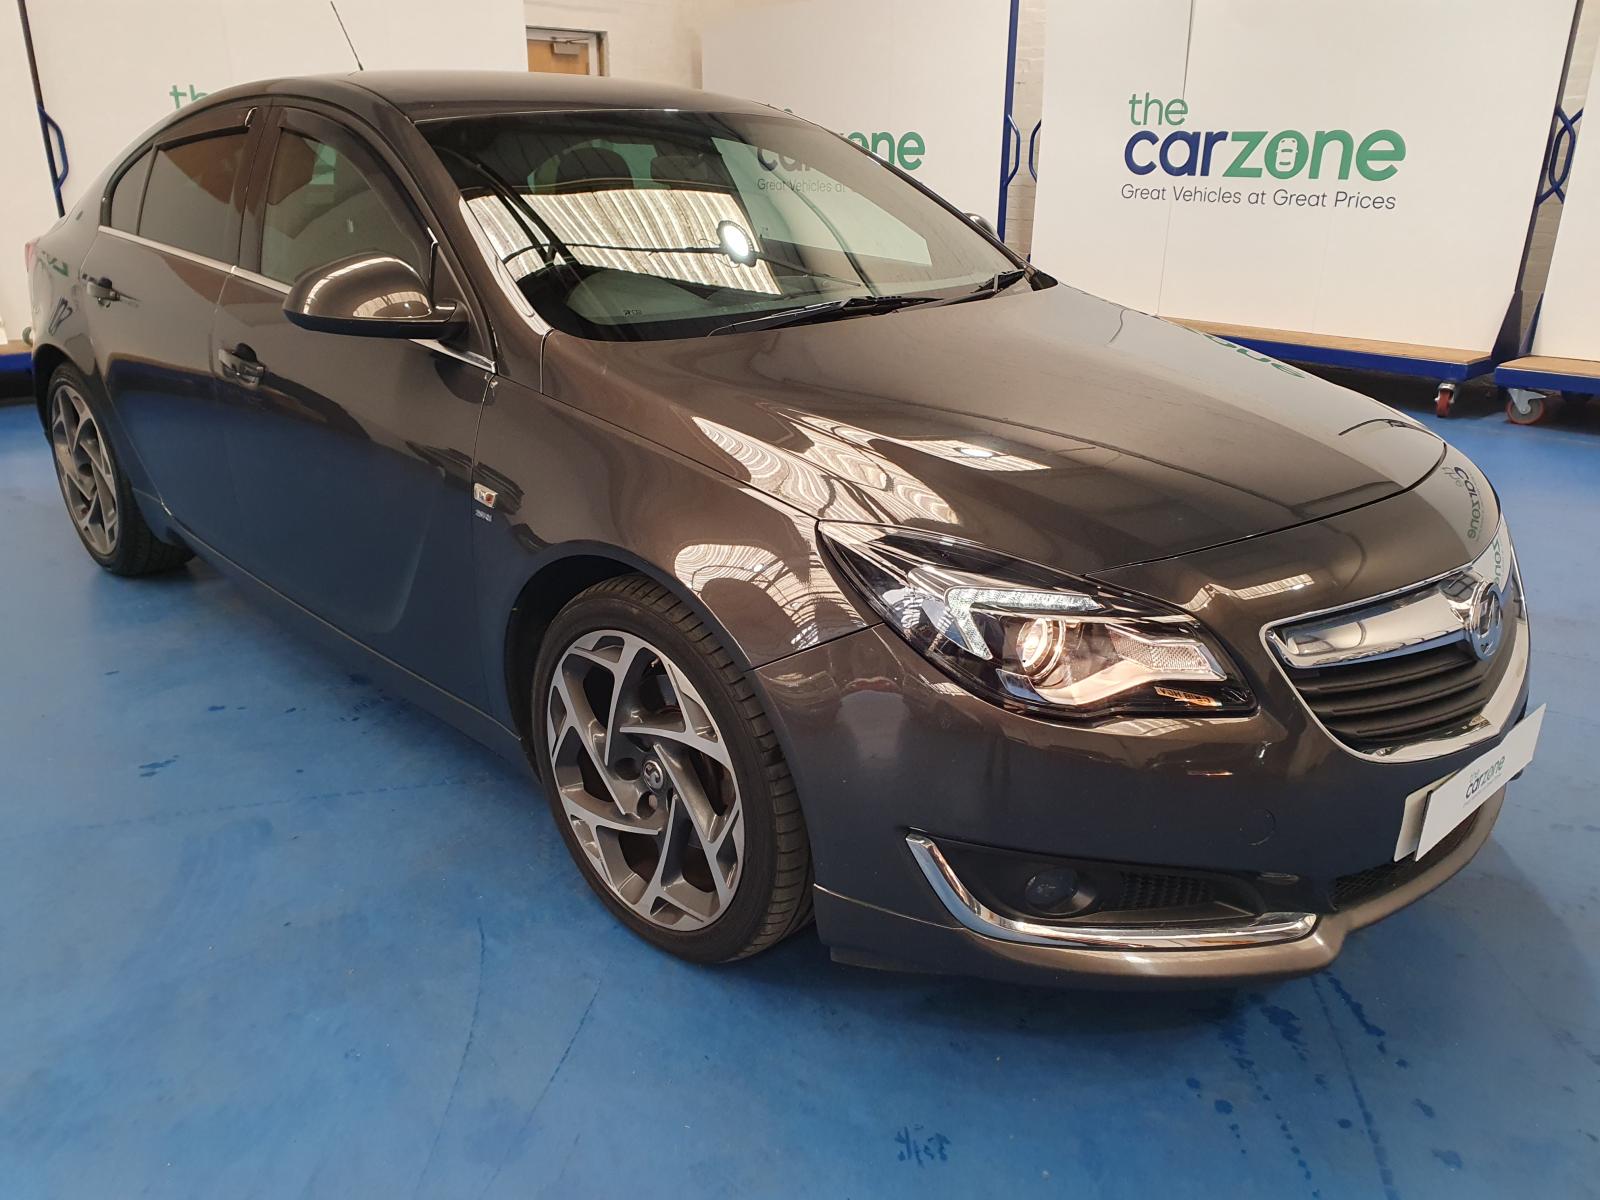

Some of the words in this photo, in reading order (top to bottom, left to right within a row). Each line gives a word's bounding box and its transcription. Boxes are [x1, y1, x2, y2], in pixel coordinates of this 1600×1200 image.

[1128, 92, 1189, 126] the
[1124, 129, 1407, 182] carzone
[1121, 183, 1167, 201] Great
[1173, 186, 1242, 204] Vehicles
[1247, 190, 1267, 206] at
[1273, 188, 1328, 207] Great
[1334, 191, 1397, 210] Prices
